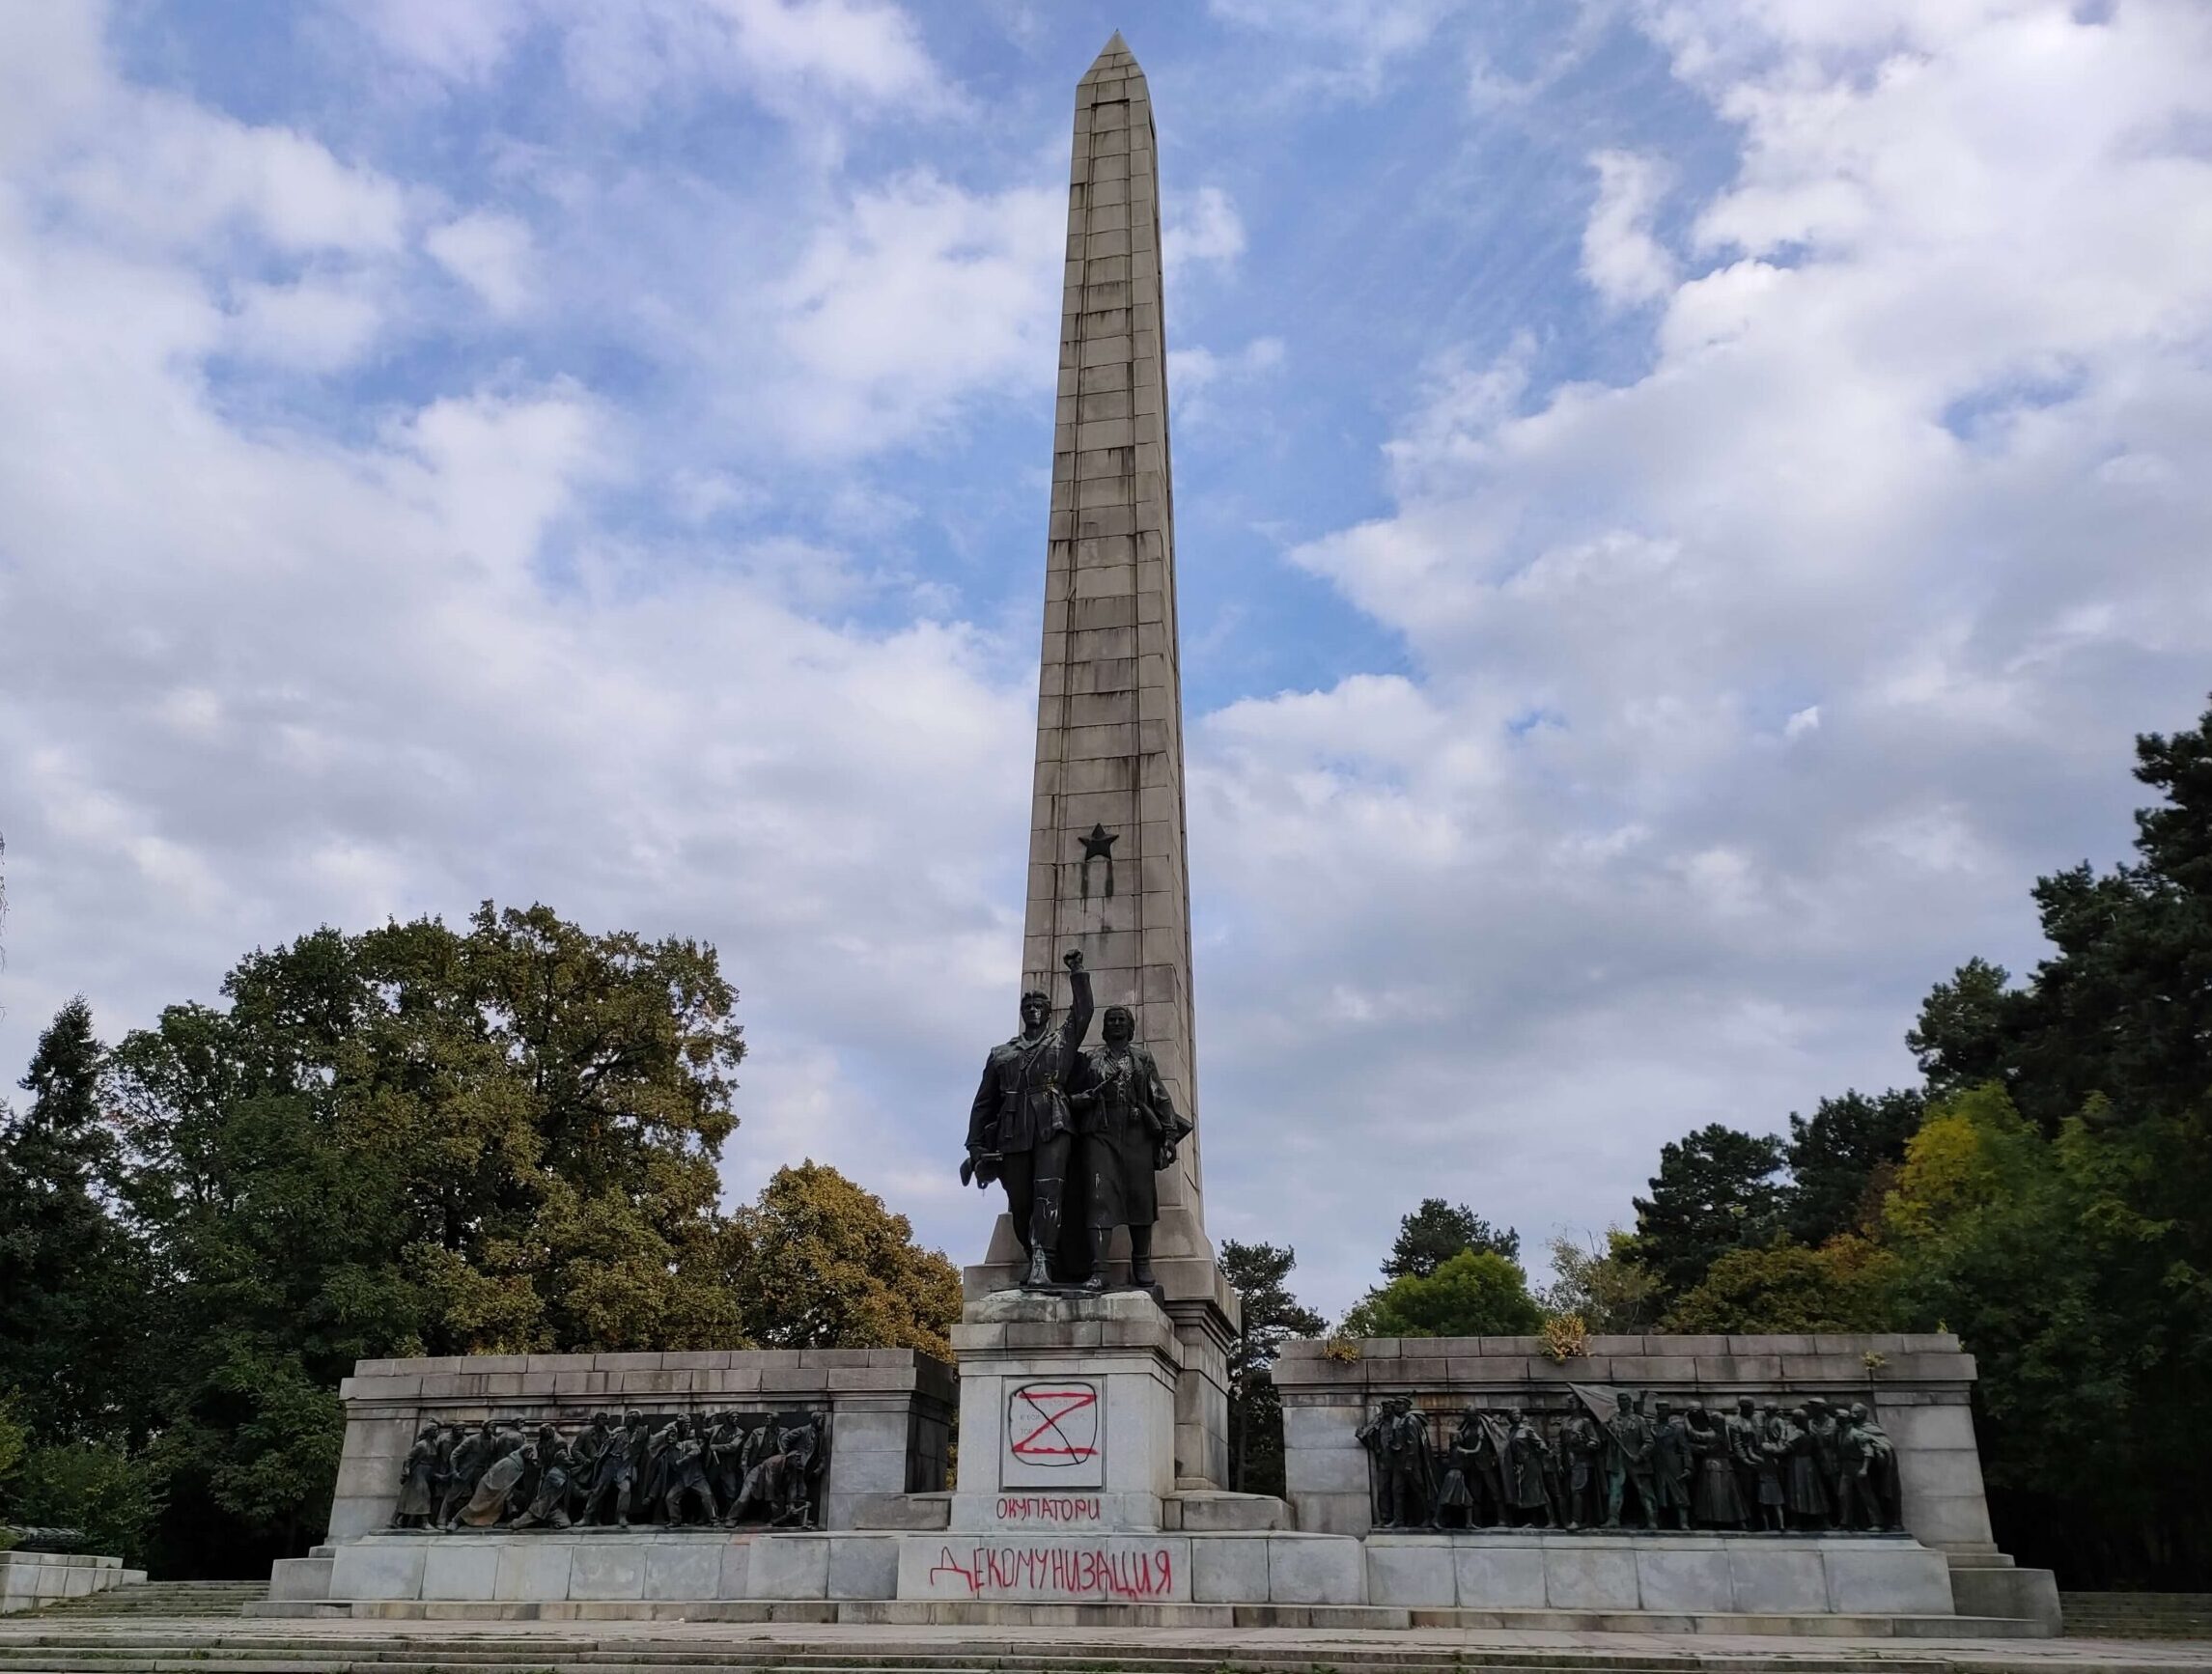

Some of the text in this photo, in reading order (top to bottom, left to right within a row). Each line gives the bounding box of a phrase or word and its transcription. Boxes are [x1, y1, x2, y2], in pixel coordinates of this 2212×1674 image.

[1011, 1391, 1099, 1455] Z
[996, 1497, 1101, 1521] ОКУПАТОРИ
[930, 1546, 1172, 1599] ДЕКОМУНИЗАЦИЯ
